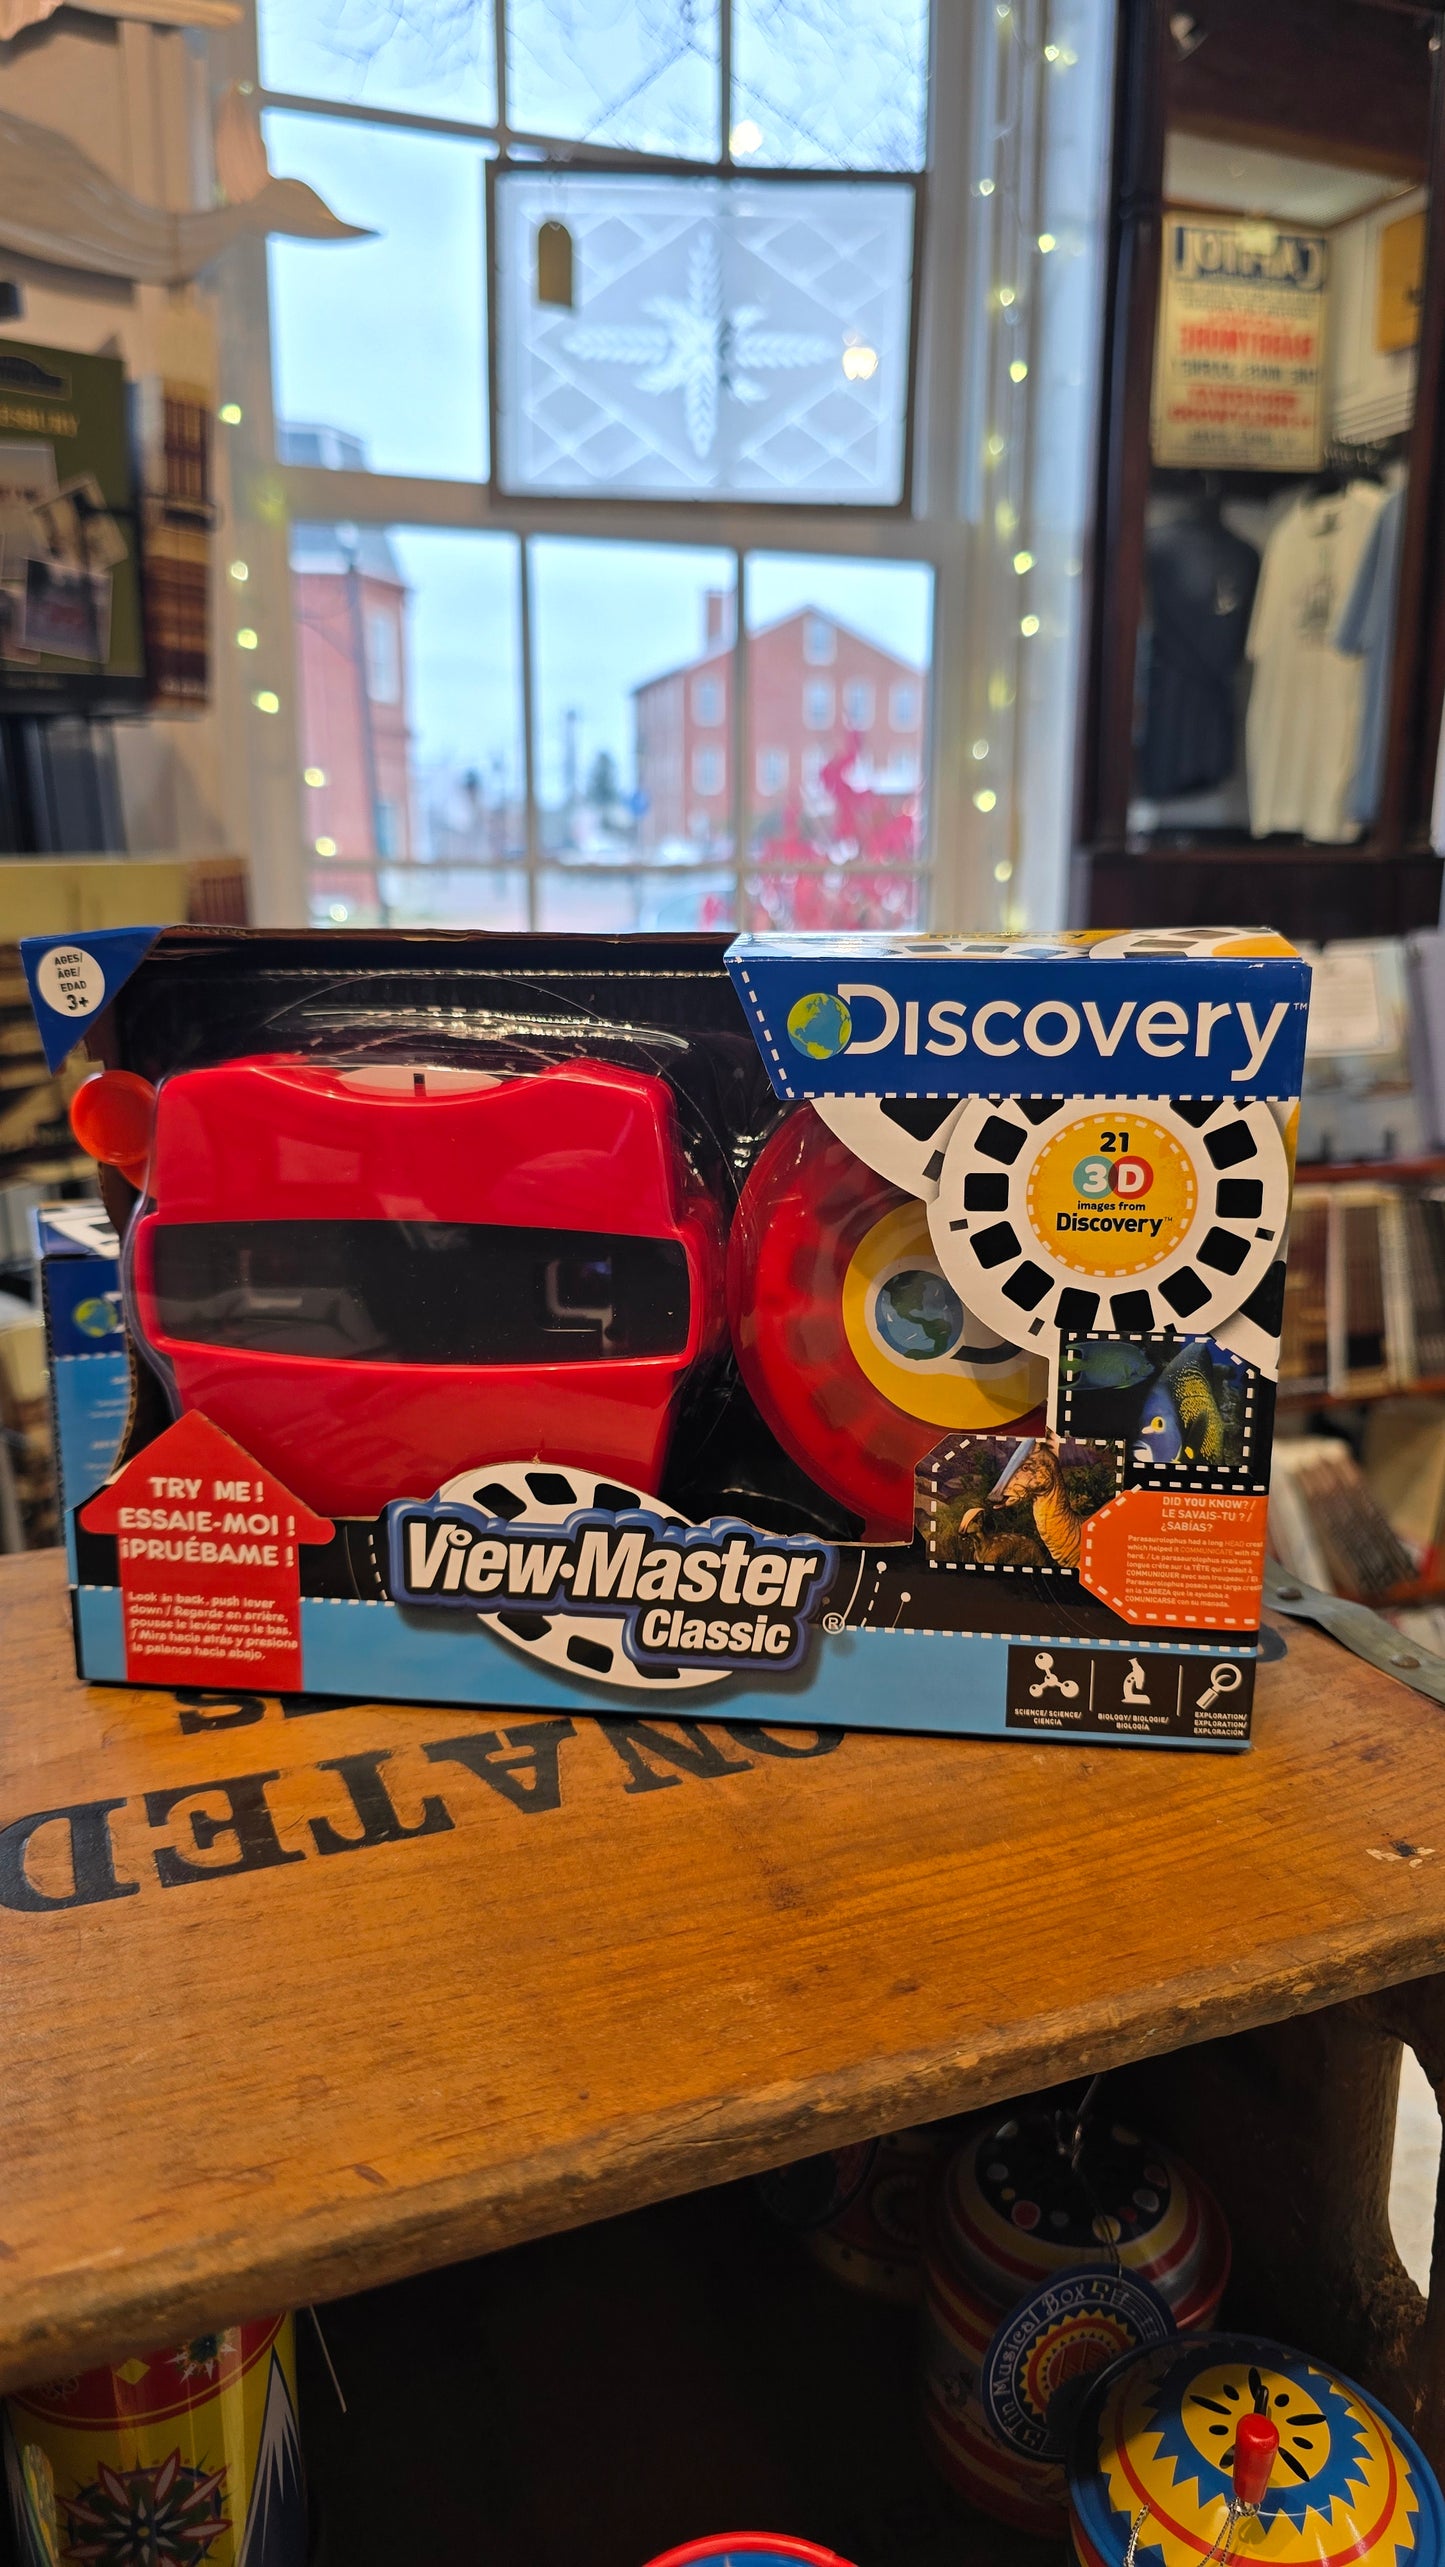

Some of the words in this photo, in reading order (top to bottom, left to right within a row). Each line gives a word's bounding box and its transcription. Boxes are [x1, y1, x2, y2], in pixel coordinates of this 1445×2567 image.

[54, 952, 82, 966] AGES/
[60, 980, 86, 992] EDAD
[66, 994, 89, 1010] 3+
[1100, 1131, 1130, 1152] 21
[1082, 1163, 1145, 1193] 3D
[1077, 1201, 1116, 1212] images
[1118, 1202, 1146, 1211] from
[149, 1476, 203, 1500] TRY
[1163, 1496, 1181, 1506] DID
[1184, 1497, 1206, 1508] YOU
[1209, 1498, 1250, 1510] KNOW?
[118, 1507, 279, 1536] ESSAIE-MOI
[1162, 1508, 1176, 1518] LE
[1178, 1510, 1236, 1521] SAVAIS-TU
[1161, 1520, 1214, 1532] ¿SABÍAS?
[1208, 1540, 1224, 1548] long
[1126, 1561, 1150, 1570] longue
[1126, 1570, 1180, 1579] COMMUNIQUER
[1143, 1587, 1172, 1596] CABEZA
[128, 1592, 158, 1602] Look
[161, 1593, 172, 1602] in
[211, 1596, 240, 1608] push
[244, 1598, 276, 1608] lever
[1124, 1596, 1176, 1604] COMUNICARSE
[130, 1604, 163, 1614] down
[174, 1606, 224, 1620] Regarde
[226, 1610, 242, 1620] en
[130, 1617, 174, 1629] pousse
[176, 1619, 187, 1629] le
[190, 1620, 223, 1631] levier
[225, 1622, 250, 1633] vers
[253, 1624, 264, 1634] le
[640, 1609, 791, 1654] Classic
[139, 1630, 166, 1641] Mira
[169, 1631, 201, 1642] hacia
[202, 1634, 233, 1646] atrás
[235, 1636, 244, 1646] y
[245, 1637, 298, 1650] presiona
[132, 1642, 144, 1652] la
[145, 1643, 192, 1656] palanca
[193, 1644, 226, 1657] hacia
[1014, 1708, 1048, 1718] SCIENCE/
[1048, 1710, 1082, 1719] SCIENCE/
[1098, 1712, 1132, 1722] BIOLOGY/
[1132, 1714, 1170, 1724] BIOLOGIE/
[1194, 1712, 1248, 1721] EXPLORATION/
[1033, 1718, 1062, 1727] CIENCIA
[1194, 1720, 1248, 1730] EXPLORATION/
[1041, 2281, 1086, 2317] Box
[992, 2307, 1041, 2397] Musical
[1001, 2400, 1025, 2436] Tin
